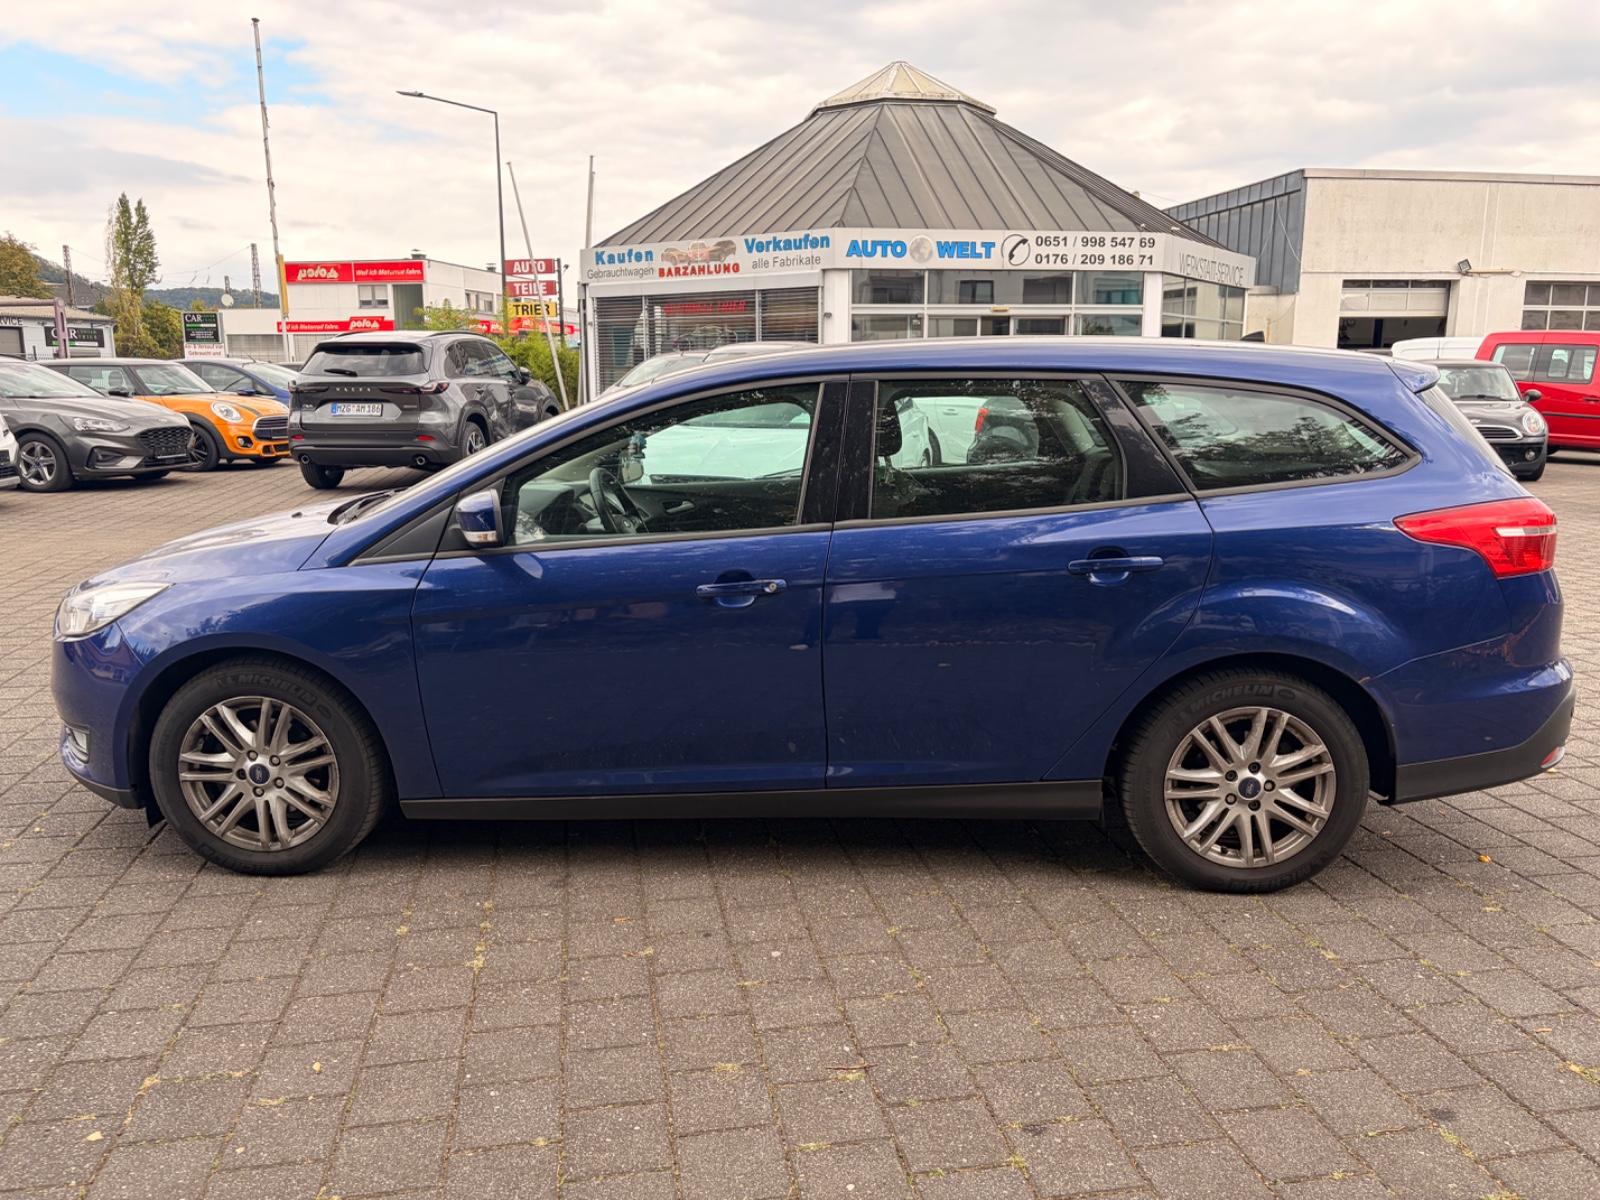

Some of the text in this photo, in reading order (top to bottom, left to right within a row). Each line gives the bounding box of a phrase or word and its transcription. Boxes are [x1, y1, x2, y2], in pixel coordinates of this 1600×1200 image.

[743, 233, 831, 254] Verkaufen
[846, 239, 996, 259] AUTO WELT
[1035, 235, 1068, 247] 0651
[1081, 236, 1106, 248] 998
[1110, 237, 1135, 248] 547
[1139, 237, 1156, 248] 69
[595, 248, 654, 265] Kaufen
[752, 253, 821, 269] alle Fabrikate
[1035, 253, 1069, 265] 0176
[1080, 254, 1106, 265] 209
[1110, 254, 1134, 265] 186
[1139, 255, 1154, 265] 71
[587, 266, 654, 280] Gebrauchtwagen
[658, 262, 740, 278] BARZAHLUNG
[513, 282, 547, 295] TEILE
[513, 303, 550, 316] TRIER
[51, 328, 78, 339] CR
[238, 674, 318, 706] MICHELIN
[1189, 683, 1274, 712] MICHELIN
